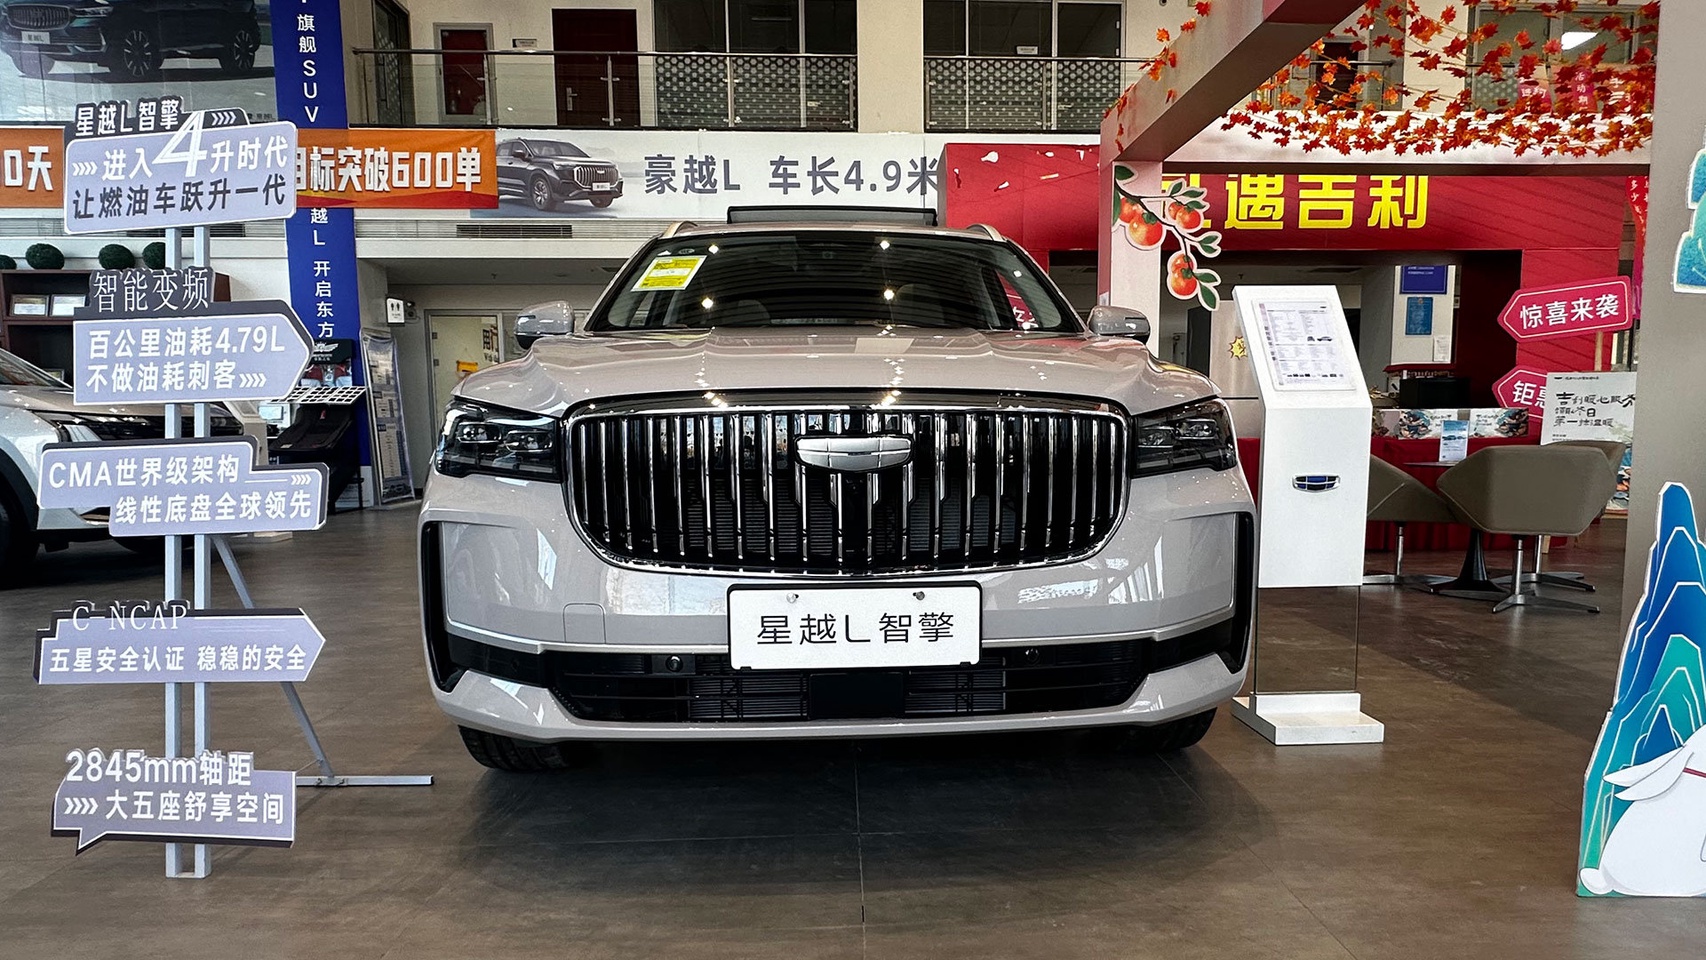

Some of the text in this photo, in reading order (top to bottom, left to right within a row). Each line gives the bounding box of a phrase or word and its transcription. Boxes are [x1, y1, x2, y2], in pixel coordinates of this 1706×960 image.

[297, 14, 318, 123] 旗舰SUV
[76, 99, 180, 136] 星越L智擎
[103, 110, 289, 181] 进入4升时代
[644, 154, 938, 196] 豪越L 车长4.9米
[73, 174, 287, 219] 让燃油车跃升一代
[94, 267, 210, 312] 智能变频
[1519, 294, 1620, 330] 惊喜来袭
[89, 325, 285, 360] 百公里油耗4.79L
[86, 359, 236, 393] 不做油耗刺客
[49, 454, 240, 489] CMA世界级架构
[115, 490, 312, 525] 线性底盘全球领先
[72, 604, 188, 631] C-NCAP
[757, 612, 954, 645] 星越L智擎
[50, 644, 307, 673] 五星安全认证 稳稳的安全
[66, 751, 252, 786] 2845mm轴距
[105, 791, 284, 825] 大五座舒享空间
